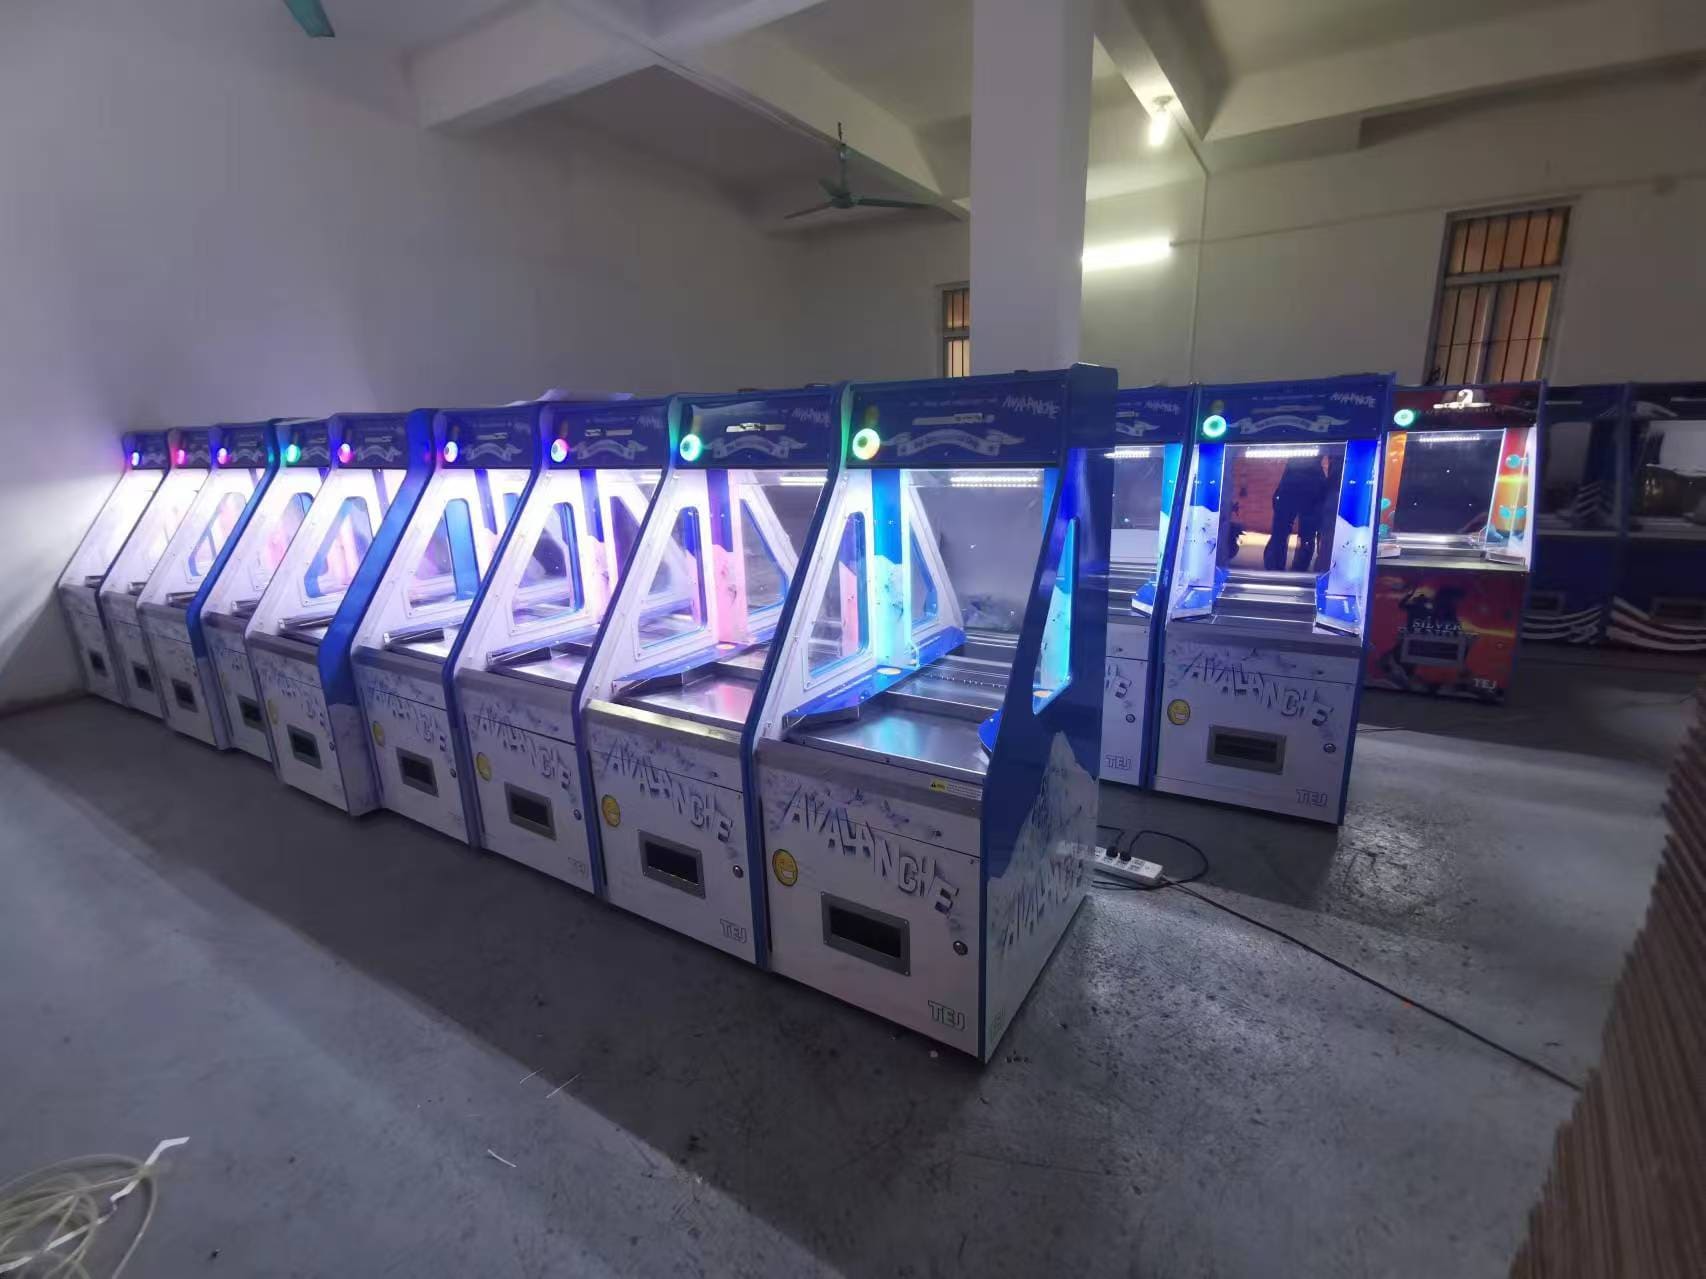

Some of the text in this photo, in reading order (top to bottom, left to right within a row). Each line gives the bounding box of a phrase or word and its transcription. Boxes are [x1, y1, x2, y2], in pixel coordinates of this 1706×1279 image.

[1183, 652, 1334, 727] AVALANCHE
[602, 736, 735, 843] AVALANCHE
[781, 784, 960, 915] AVALANCHE
[720, 918, 747, 943] TEJ
[928, 999, 967, 1032] TEJ
